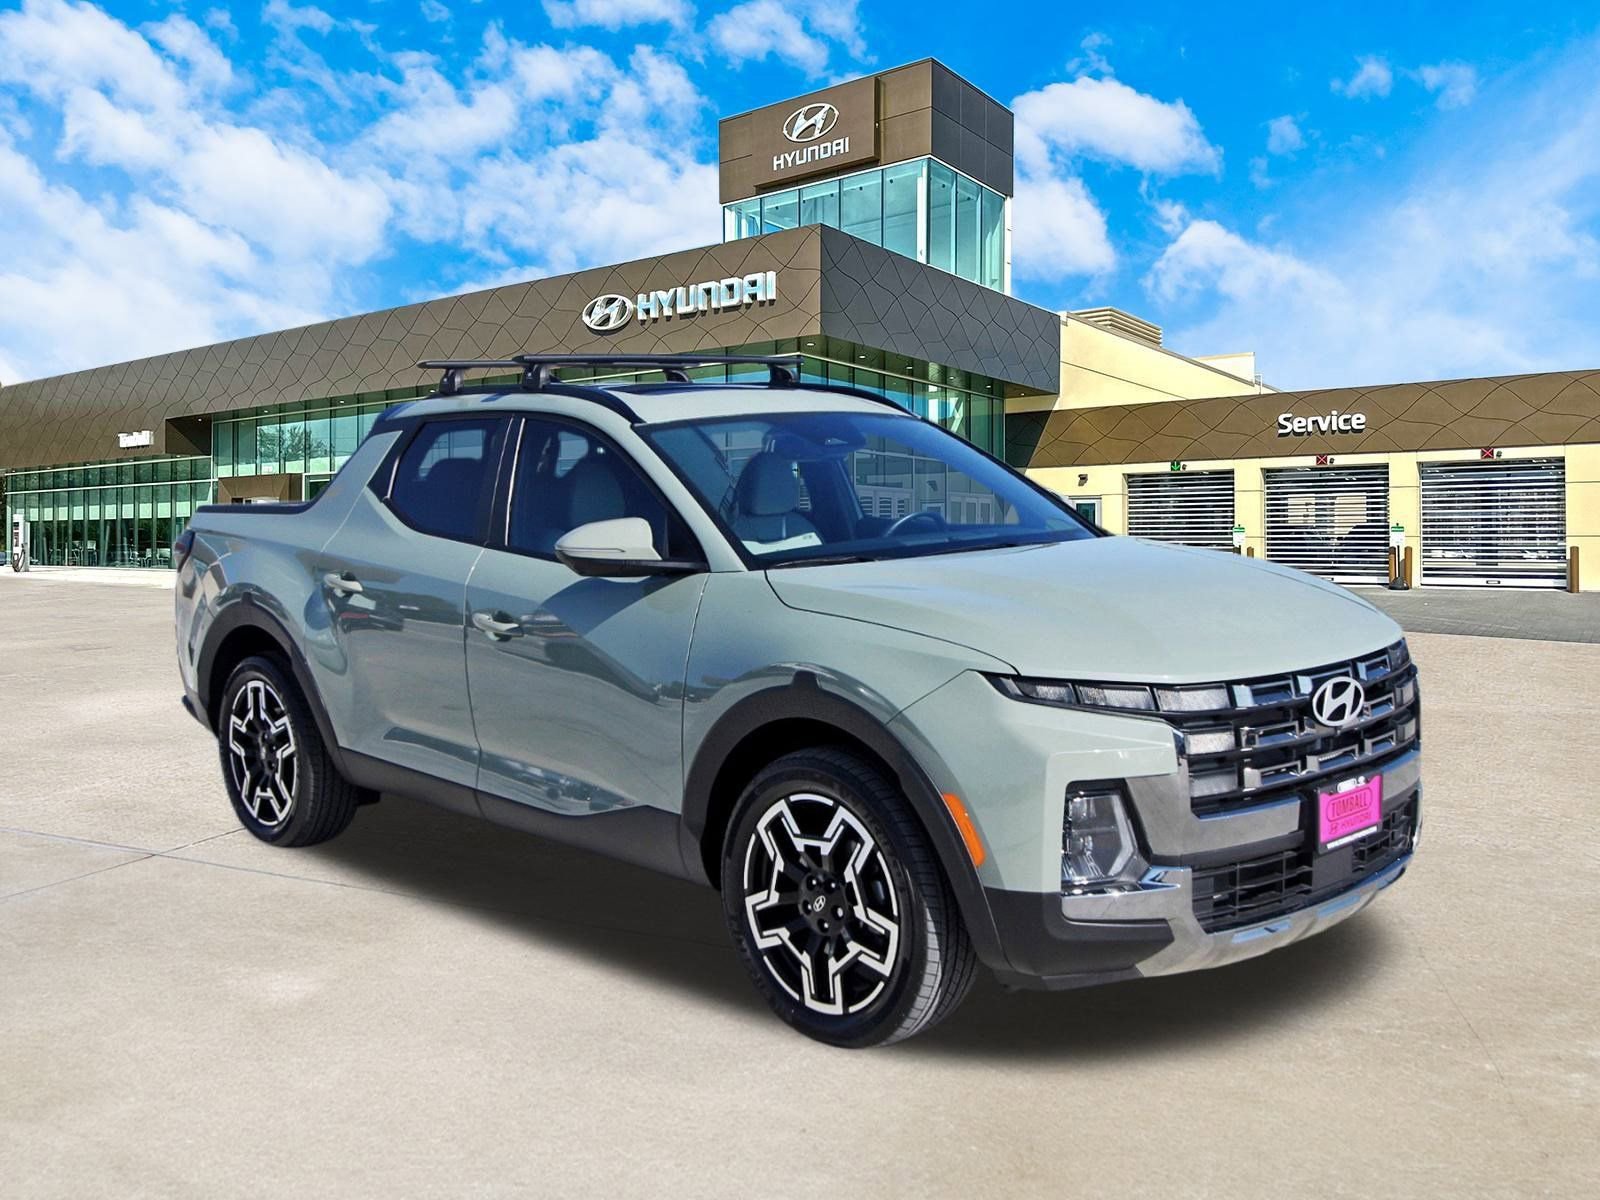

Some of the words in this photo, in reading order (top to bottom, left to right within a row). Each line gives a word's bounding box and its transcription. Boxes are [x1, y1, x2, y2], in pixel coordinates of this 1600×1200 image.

[773, 136, 850, 171] HYUNDAI
[637, 270, 777, 321] HYUNDAI
[1277, 409, 1367, 435] Service
